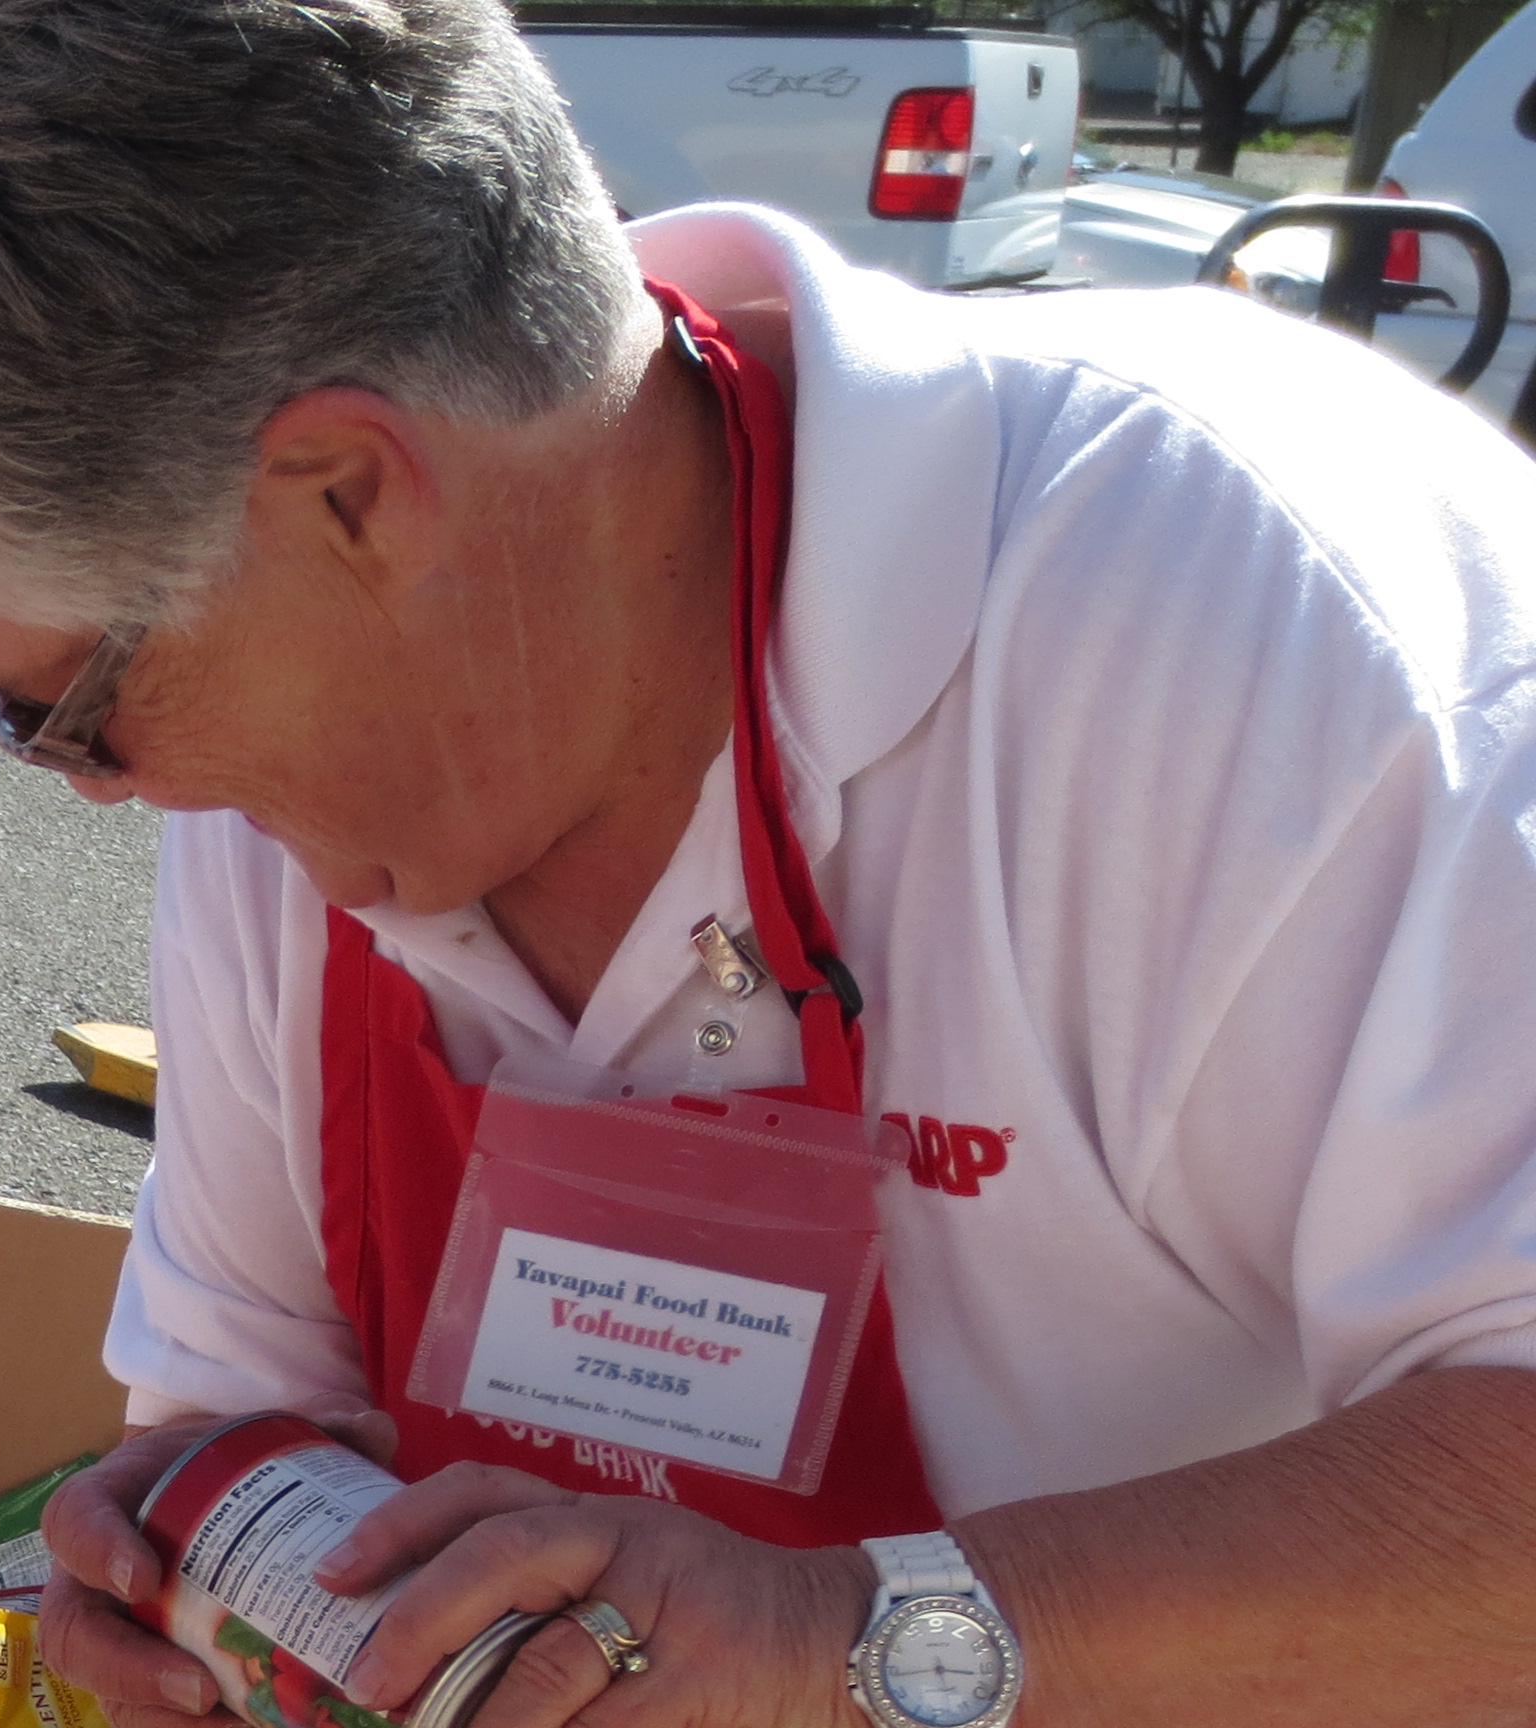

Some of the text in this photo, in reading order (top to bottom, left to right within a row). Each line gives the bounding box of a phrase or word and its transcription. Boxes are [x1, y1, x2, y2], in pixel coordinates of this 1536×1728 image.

[729, 67, 861, 97] 4x4
[514, 1258, 793, 1338] Yavapai Food Bank
[550, 1297, 743, 1366] Volunteer
[574, 1354, 692, 1397] 775-5255
[531, 1386, 762, 1450] Long Dr. Prescott Valley, AZ 86314
[179, 1500, 234, 1577] Nutrition
[230, 1463, 278, 1501] Facts
[223, 1563, 248, 1606] Calories
[244, 1572, 272, 1619] Total Fat
[277, 1584, 312, 1641] Cholesterol
[287, 1611, 310, 1649] Sodium
[298, 1633, 316, 1657] Total
[331, 1641, 356, 1681] Protein
